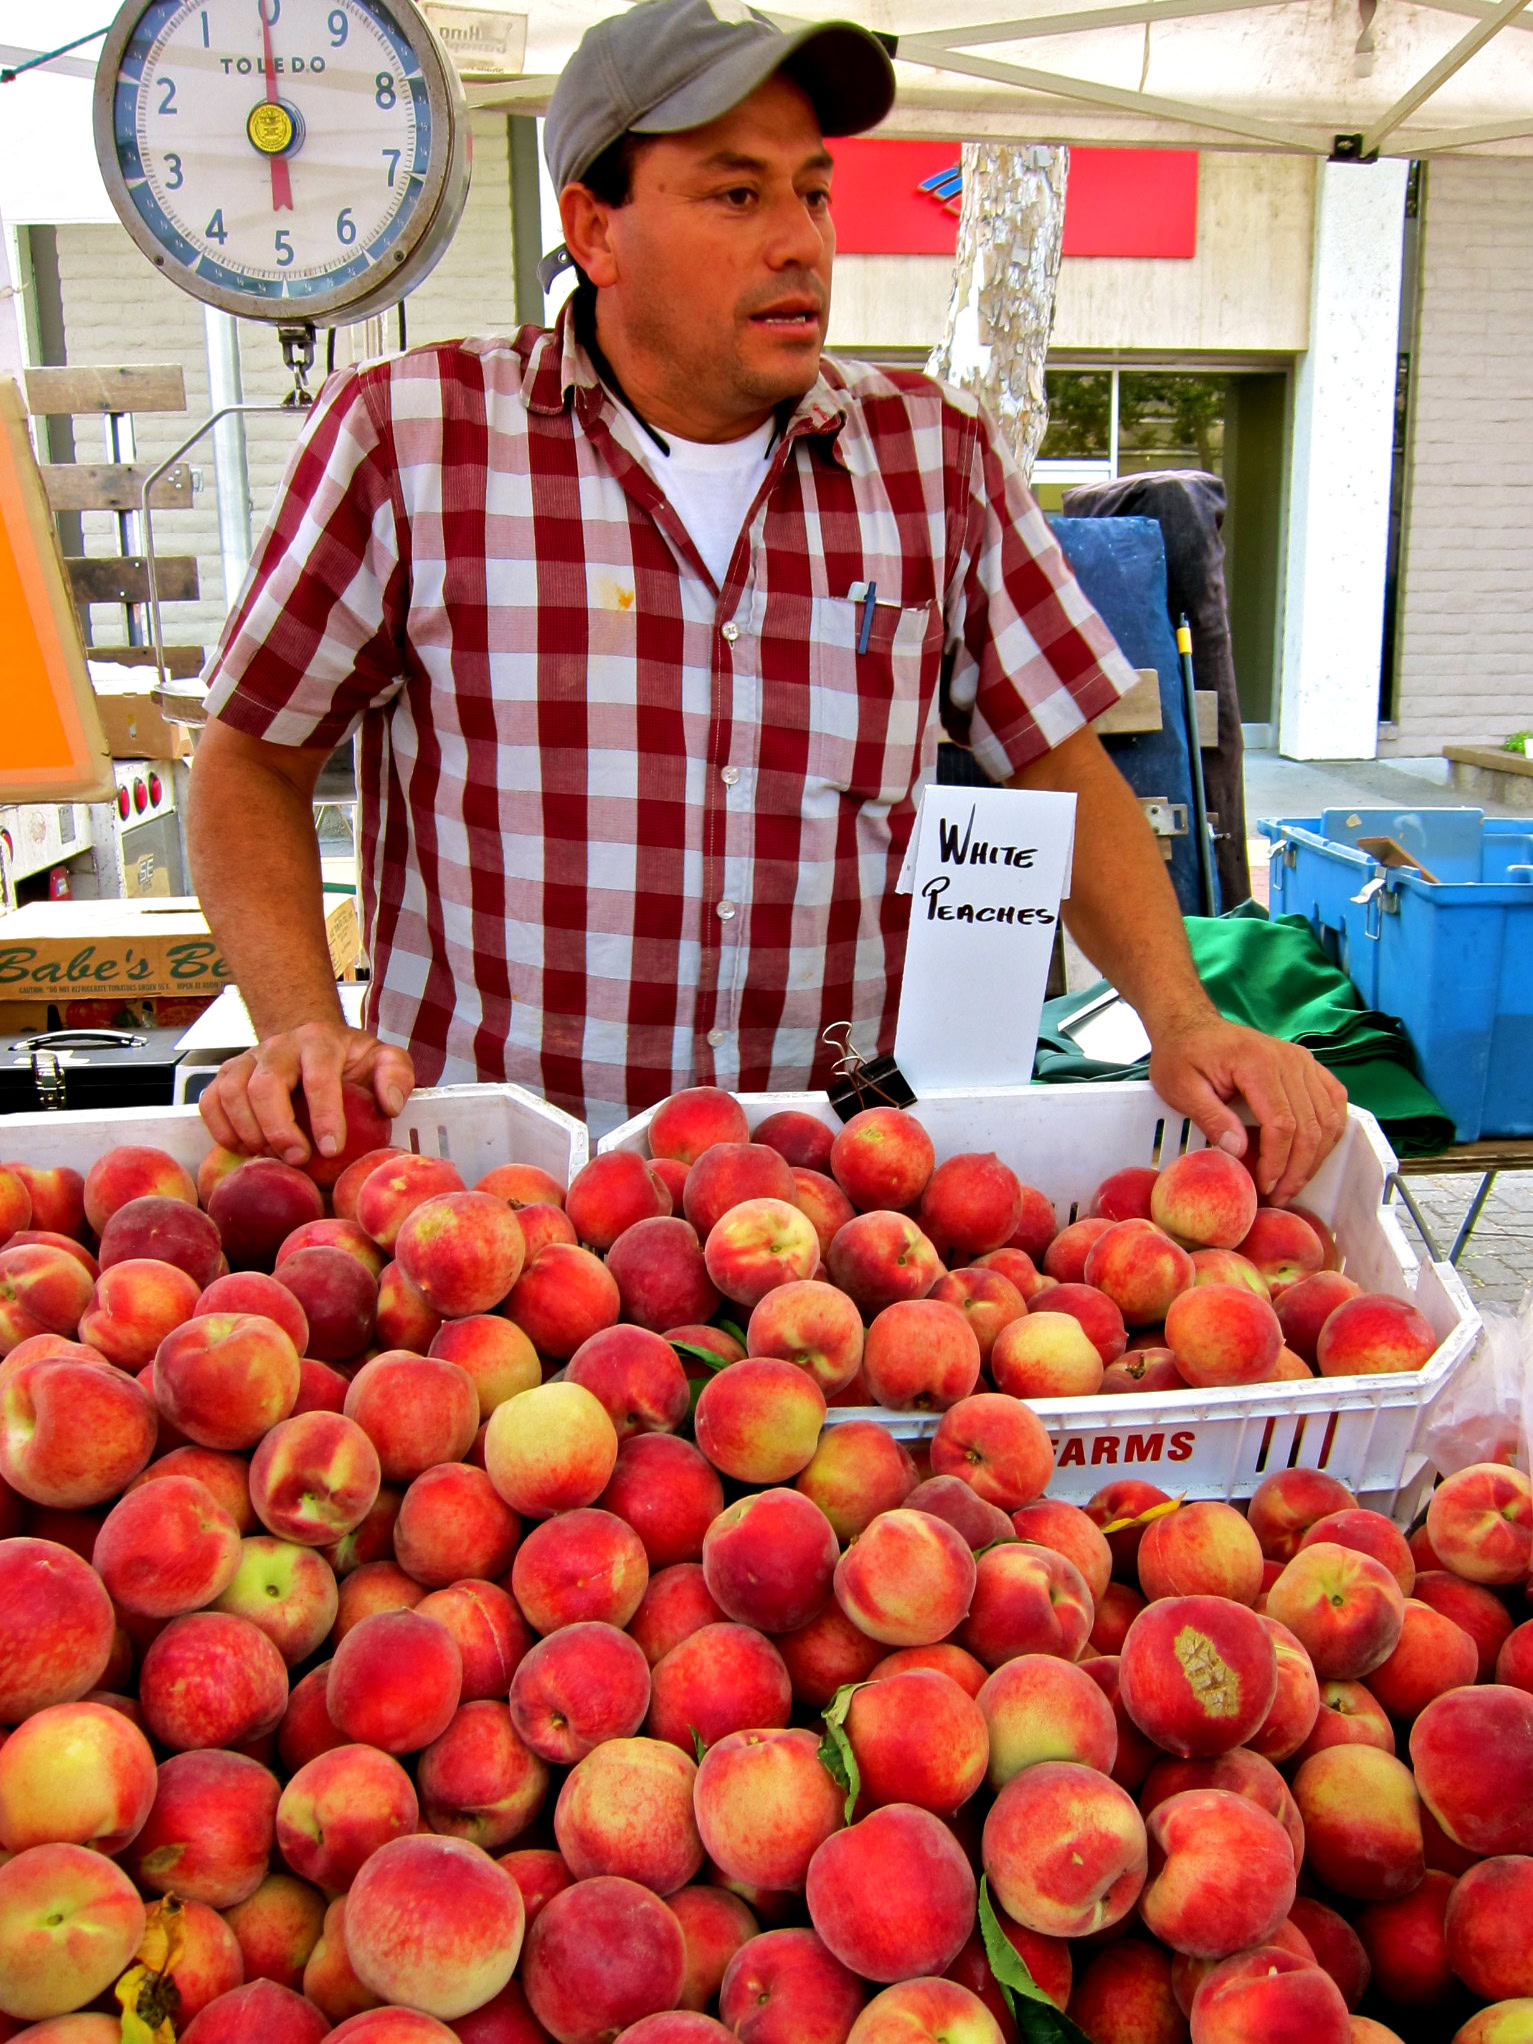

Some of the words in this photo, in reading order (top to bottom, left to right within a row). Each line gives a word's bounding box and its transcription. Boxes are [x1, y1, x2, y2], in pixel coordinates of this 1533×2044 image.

[200, 11, 210, 48] 1
[328, 9, 348, 48] 9
[220, 56, 326, 75] TOLEDO
[156, 77, 178, 114] 2
[376, 71, 397, 110] 8
[163, 153, 184, 190] 3
[381, 149, 402, 188] 7
[205, 208, 228, 245] 4
[336, 207, 357, 246] 6
[274, 229, 295, 267] 5
[939, 803, 1039, 869] WHITE
[922, 875, 1056, 926] PEACHES
[0, 946, 154, 983] Babe's
